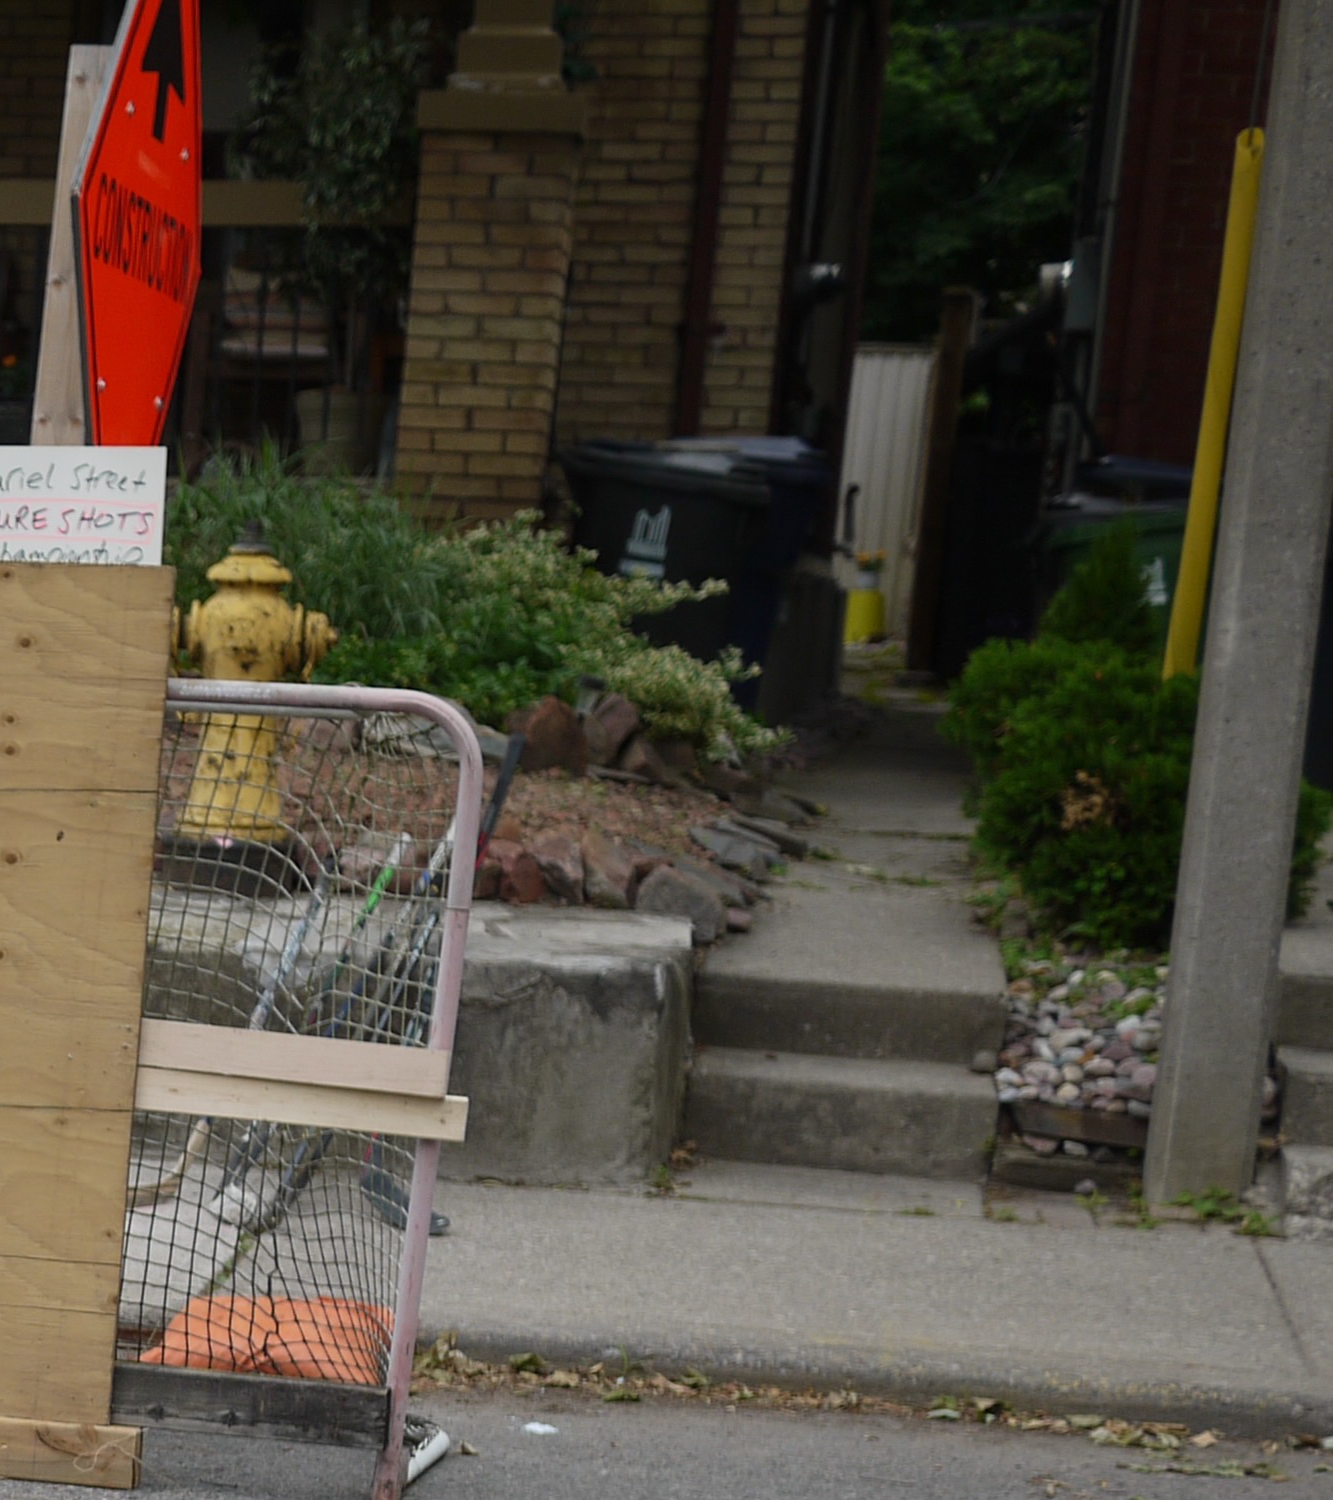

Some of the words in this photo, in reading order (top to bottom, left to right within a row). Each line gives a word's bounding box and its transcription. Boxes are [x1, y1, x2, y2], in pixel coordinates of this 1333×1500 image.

[93, 172, 192, 304] CONSTRUCTION
[70, 463, 146, 492] Street
[58, 507, 154, 535] SHOTS
